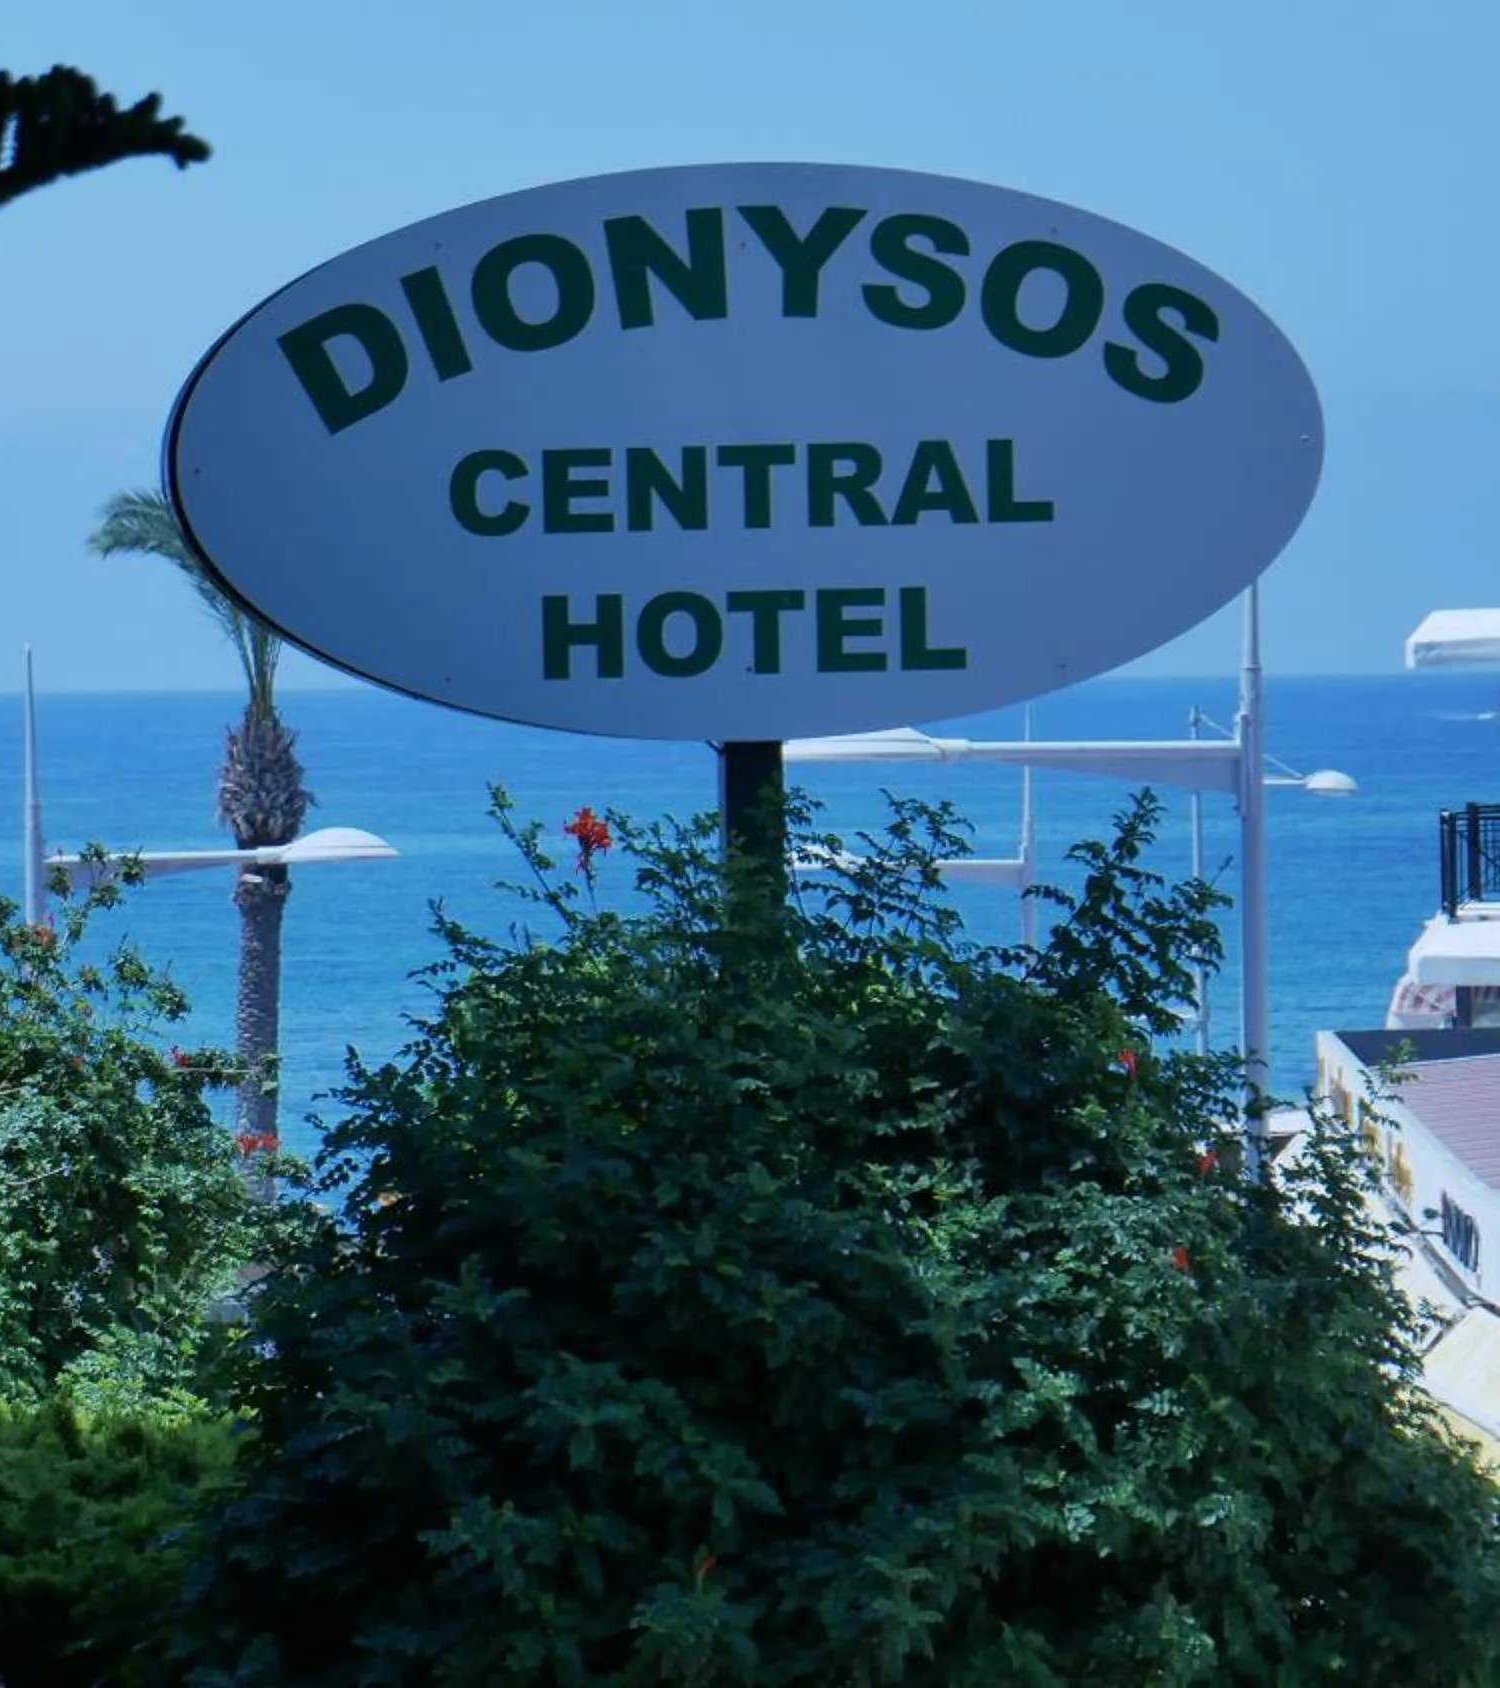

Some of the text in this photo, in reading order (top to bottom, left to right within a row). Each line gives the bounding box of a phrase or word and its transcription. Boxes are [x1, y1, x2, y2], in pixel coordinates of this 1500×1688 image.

[276, 205, 1220, 436] DIONYSOS
[449, 438, 1056, 537] CENTRAL
[541, 585, 969, 681] HOTEL
